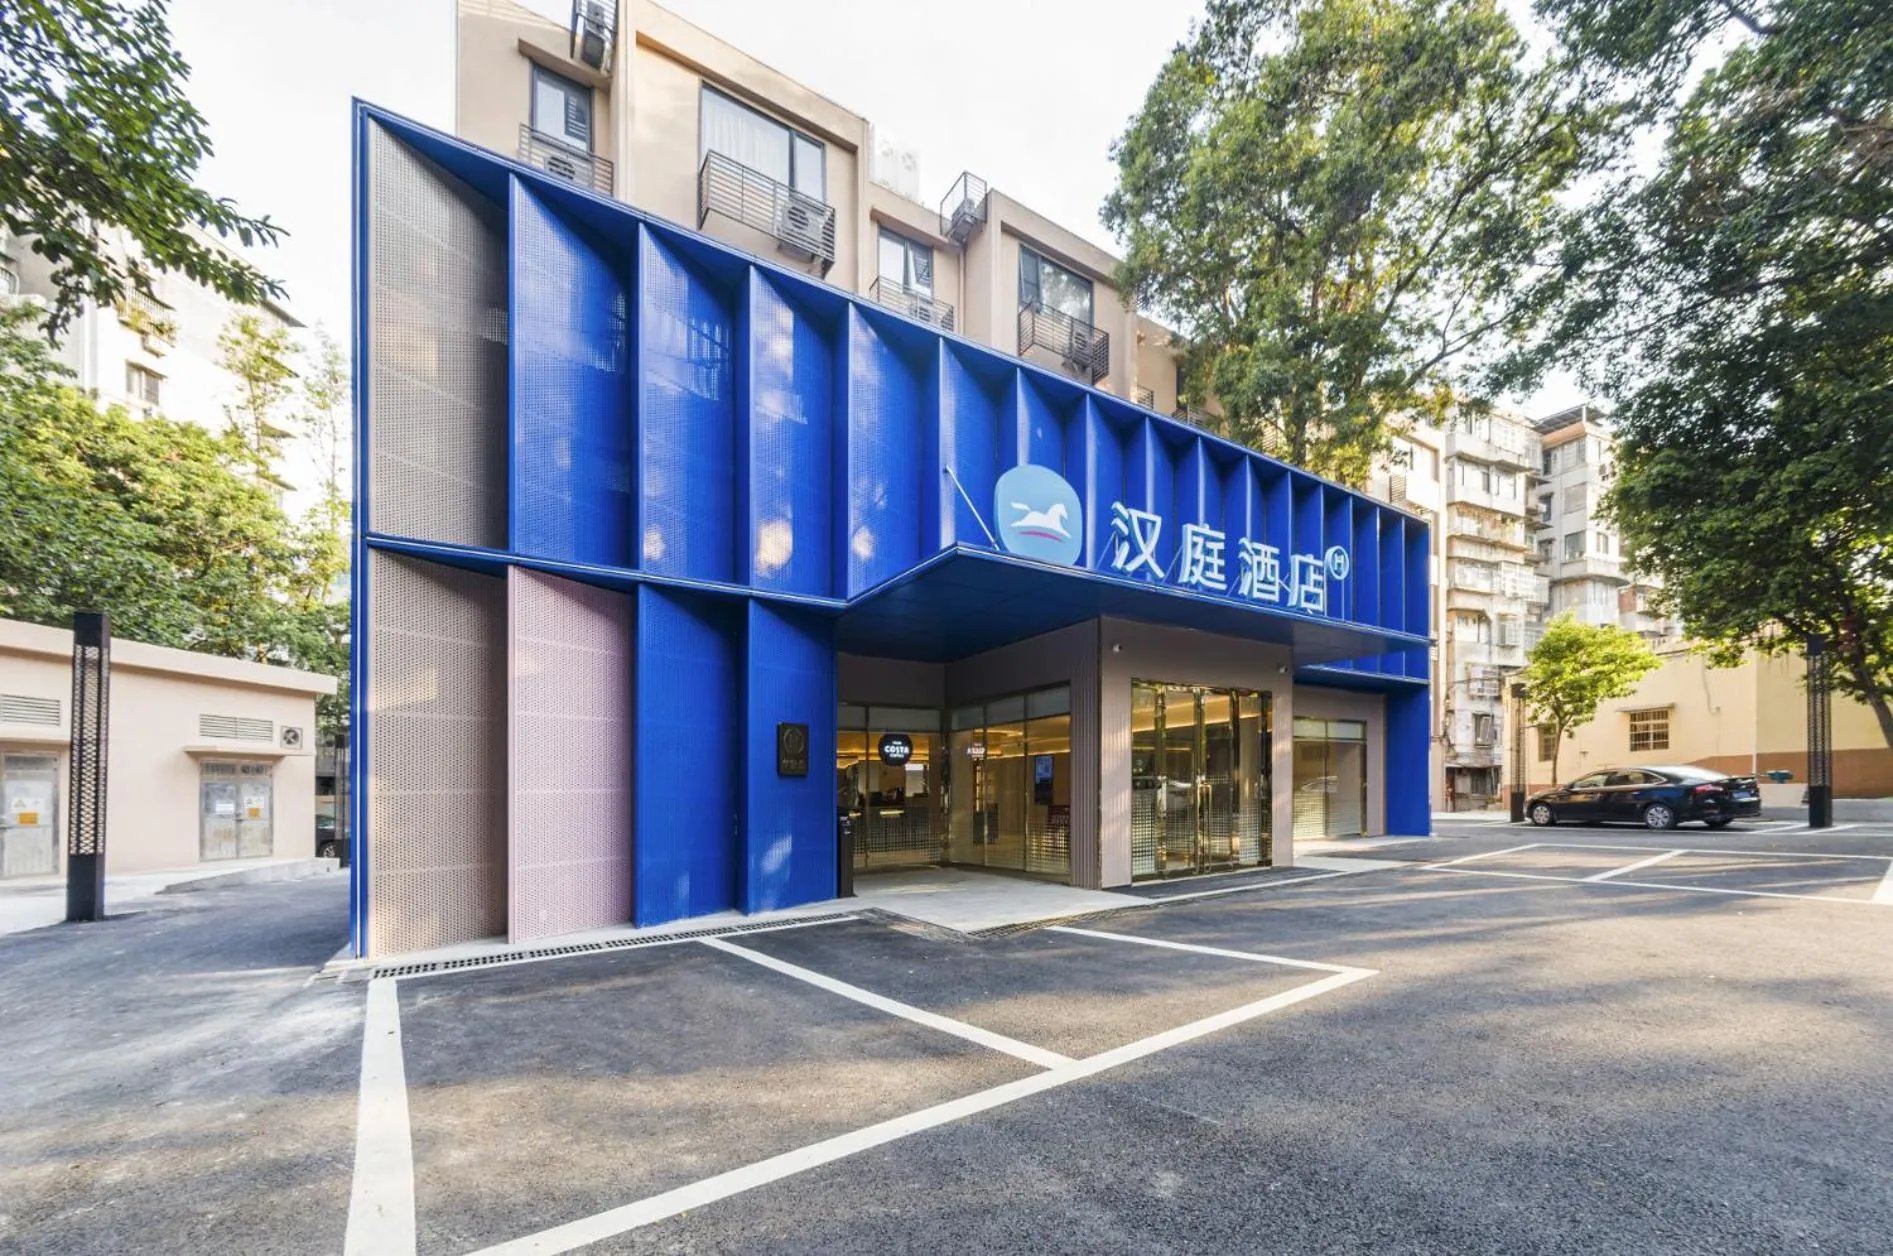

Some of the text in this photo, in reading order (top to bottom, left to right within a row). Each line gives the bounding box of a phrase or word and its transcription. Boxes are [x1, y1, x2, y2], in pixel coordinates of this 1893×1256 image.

[1111, 501, 1324, 613] 汉庭酒店
[884, 745, 910, 754] COSTA
